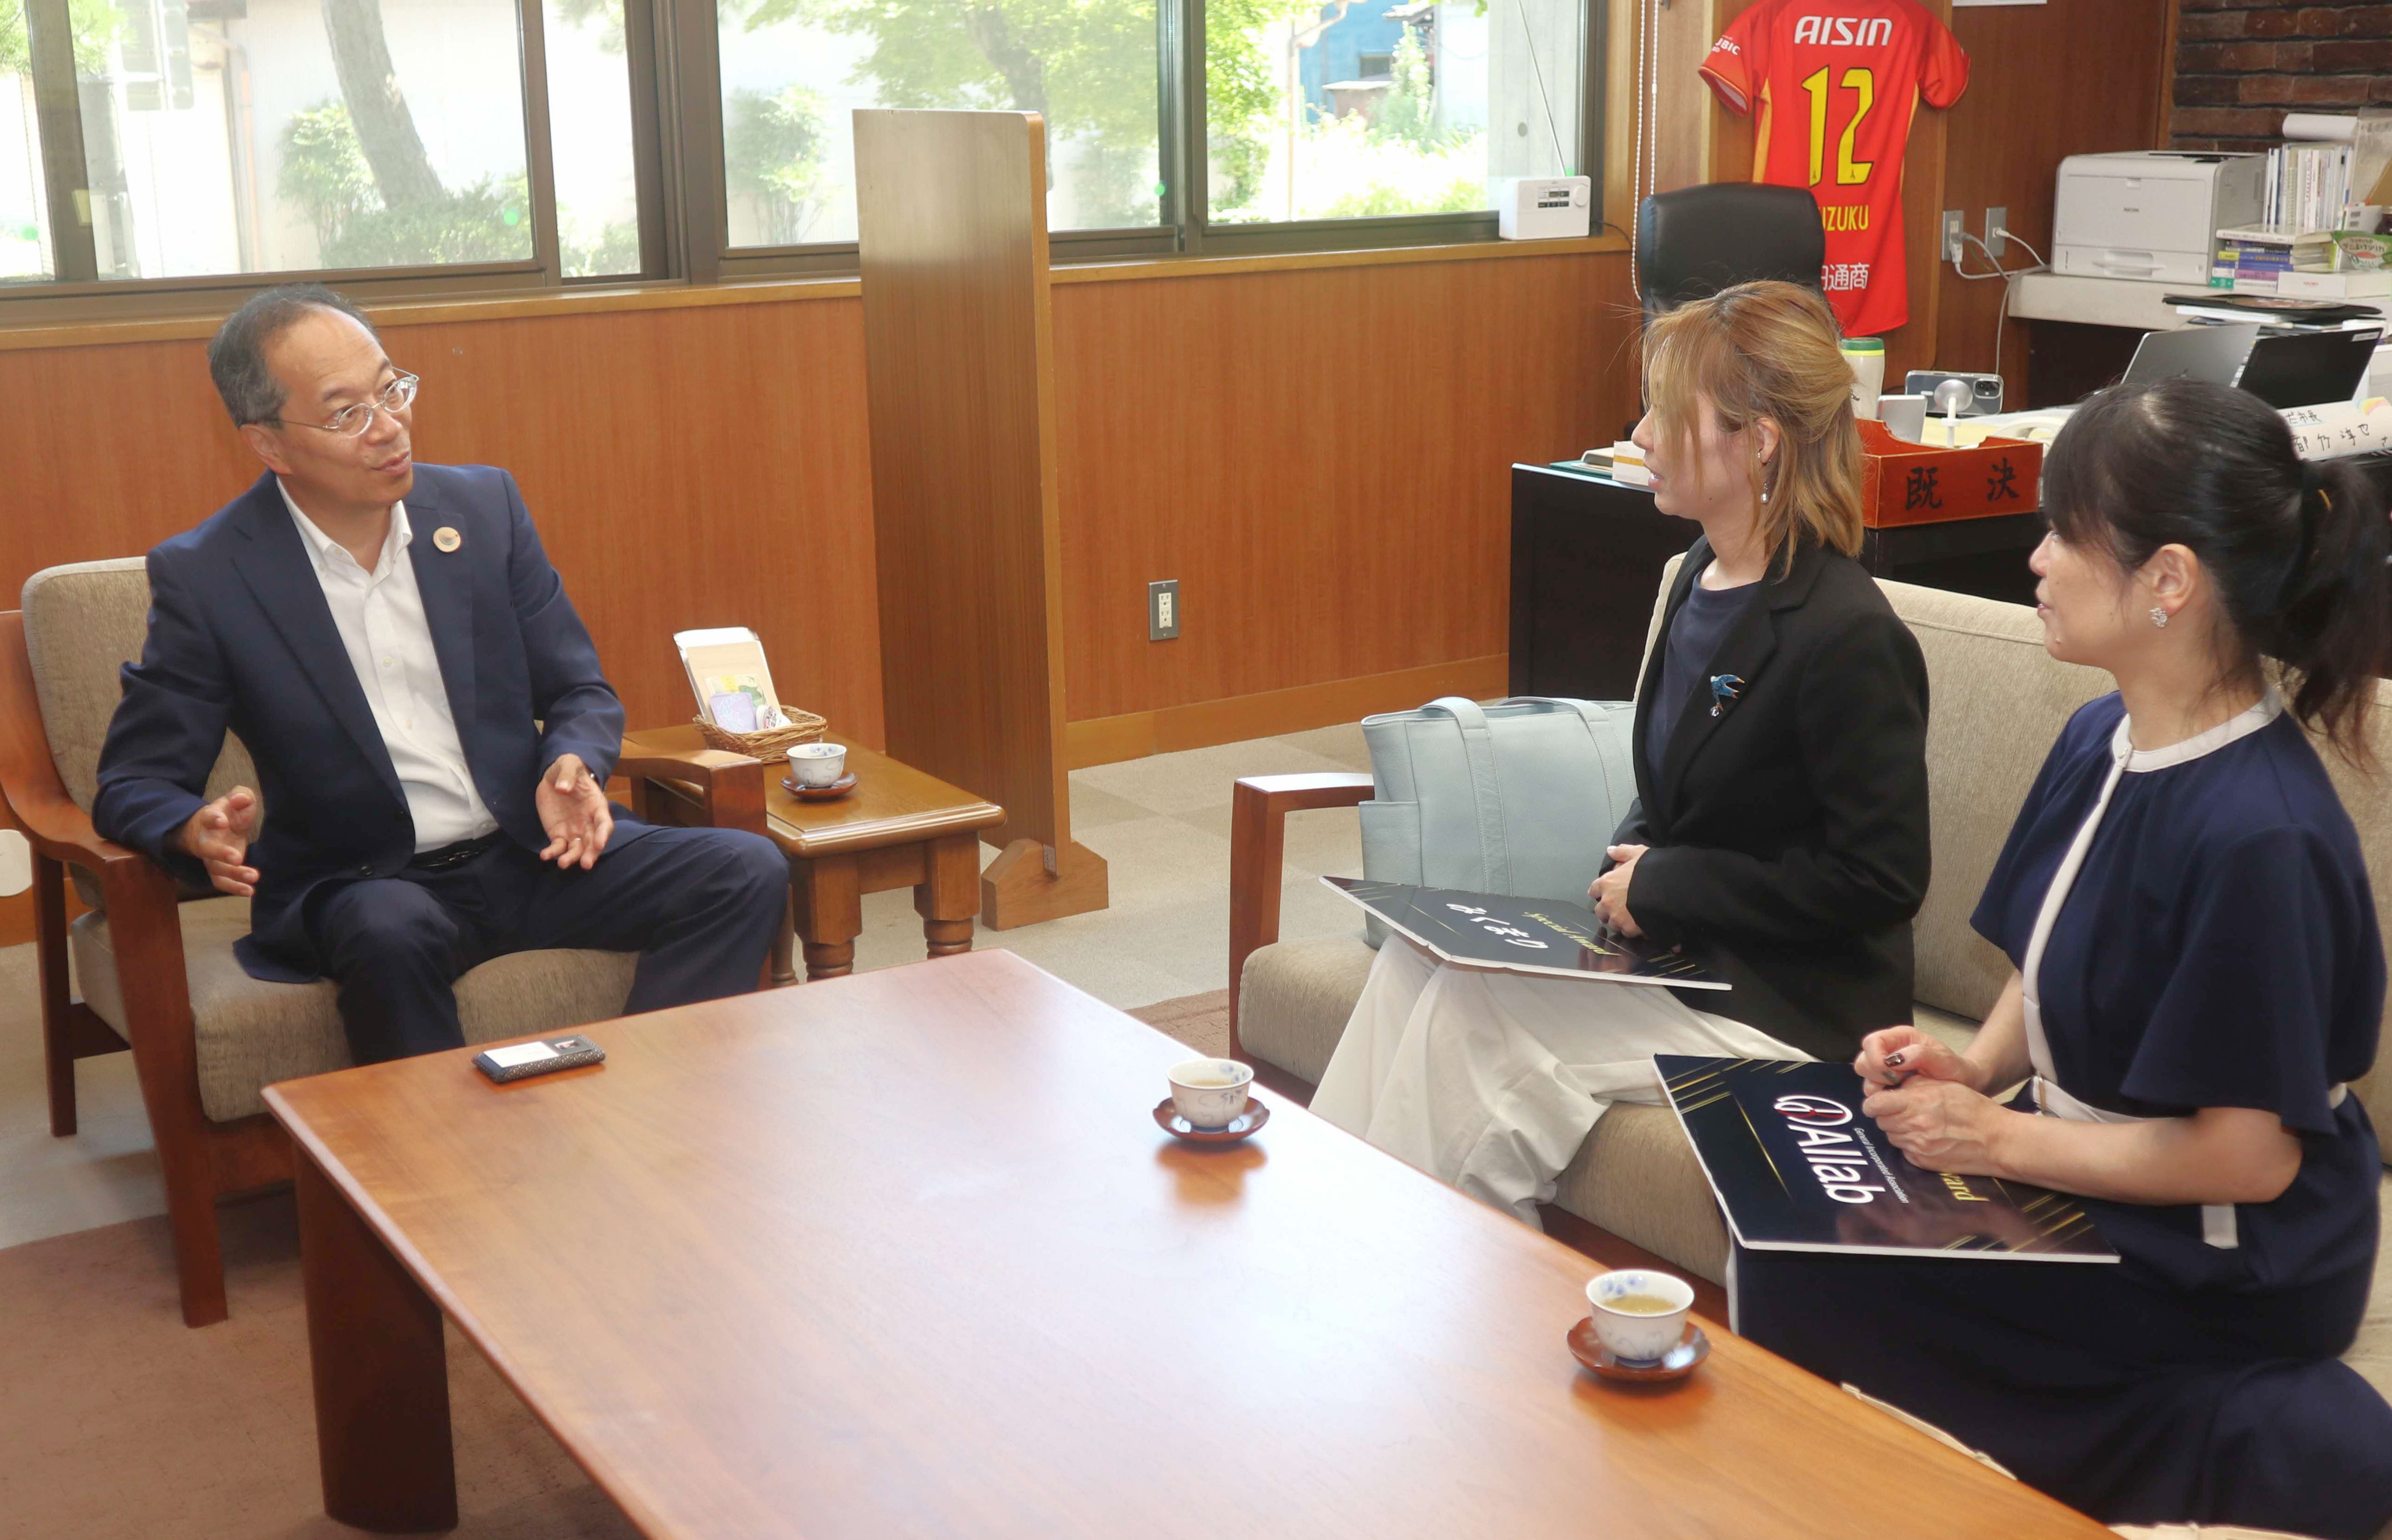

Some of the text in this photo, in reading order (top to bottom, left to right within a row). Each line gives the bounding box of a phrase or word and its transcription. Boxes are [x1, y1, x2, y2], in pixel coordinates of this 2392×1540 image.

[1794, 15, 1893, 46] AISIN
[1801, 65, 1874, 188] 12
[1905, 457, 2020, 511] 既決
[1446, 903, 1549, 949] みくまり
[1522, 911, 1622, 956] Special Award
[1787, 1124, 1886, 1204] Allab
[1854, 1127, 1909, 1204] General Incorporated Association
